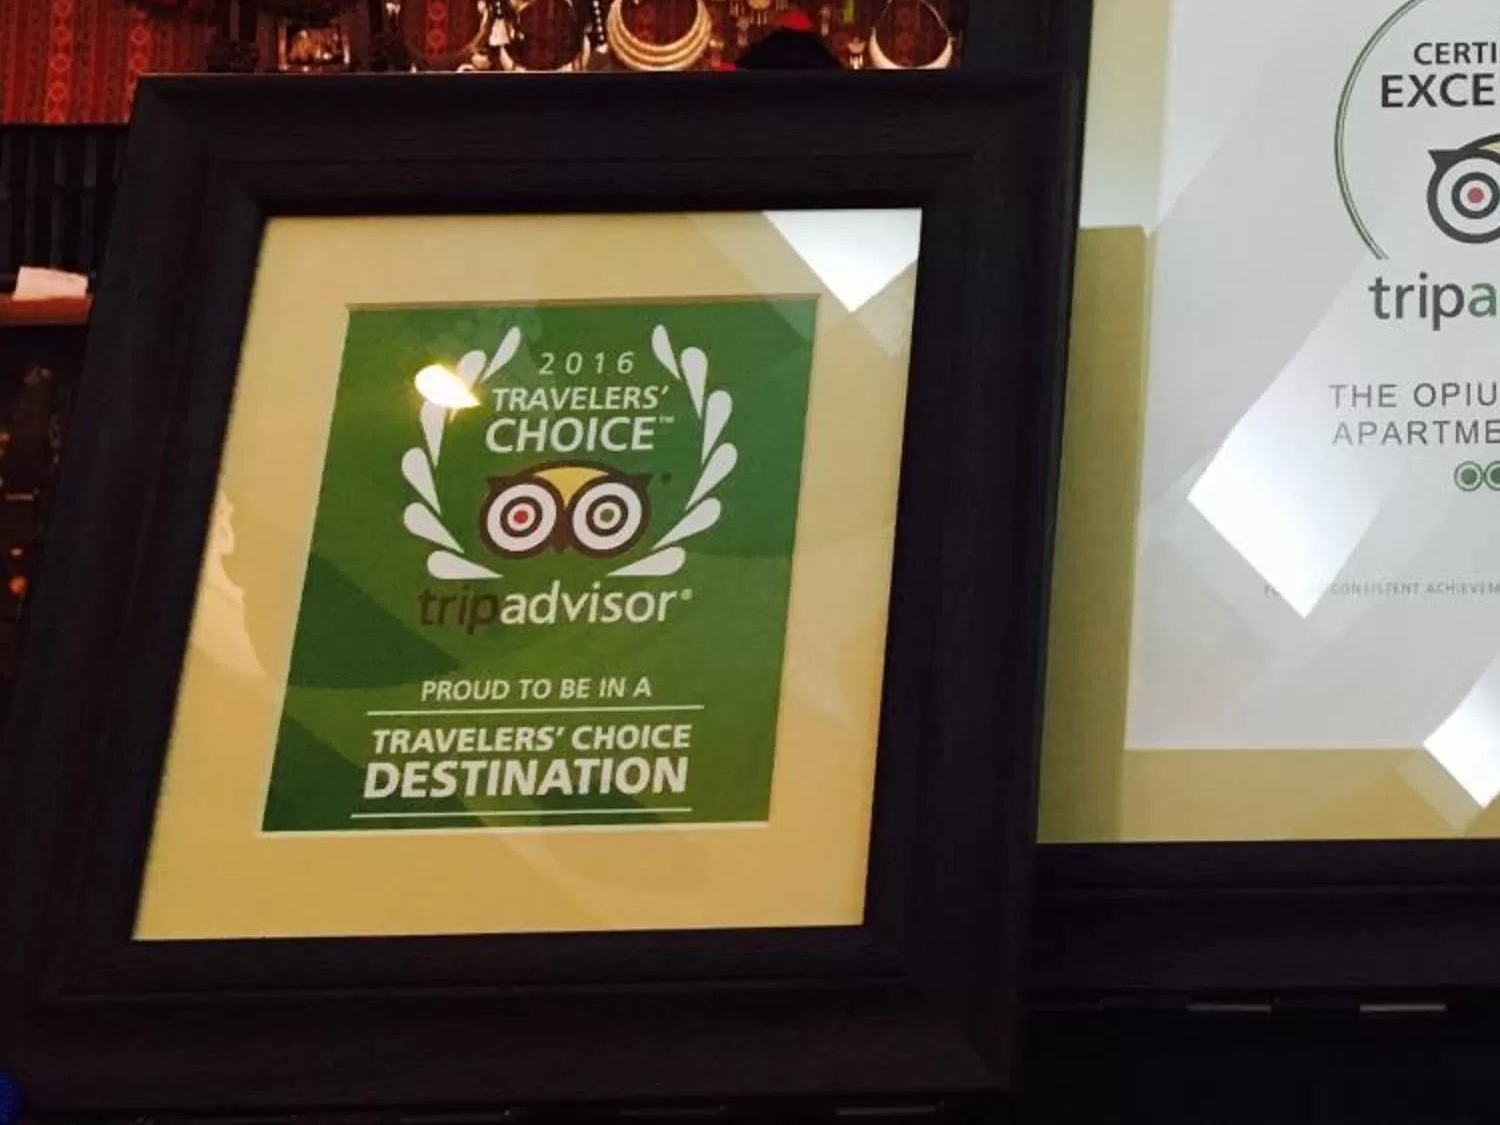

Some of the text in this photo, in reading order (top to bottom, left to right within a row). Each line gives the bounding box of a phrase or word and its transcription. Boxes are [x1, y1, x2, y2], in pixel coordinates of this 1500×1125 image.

[538, 351, 635, 376] 2016
[1329, 383, 1398, 409] THE
[420, 676, 653, 702] PROUD TO BE IN A
[571, 724, 693, 751] CHOICE
[363, 756, 689, 800] DESTINATION
